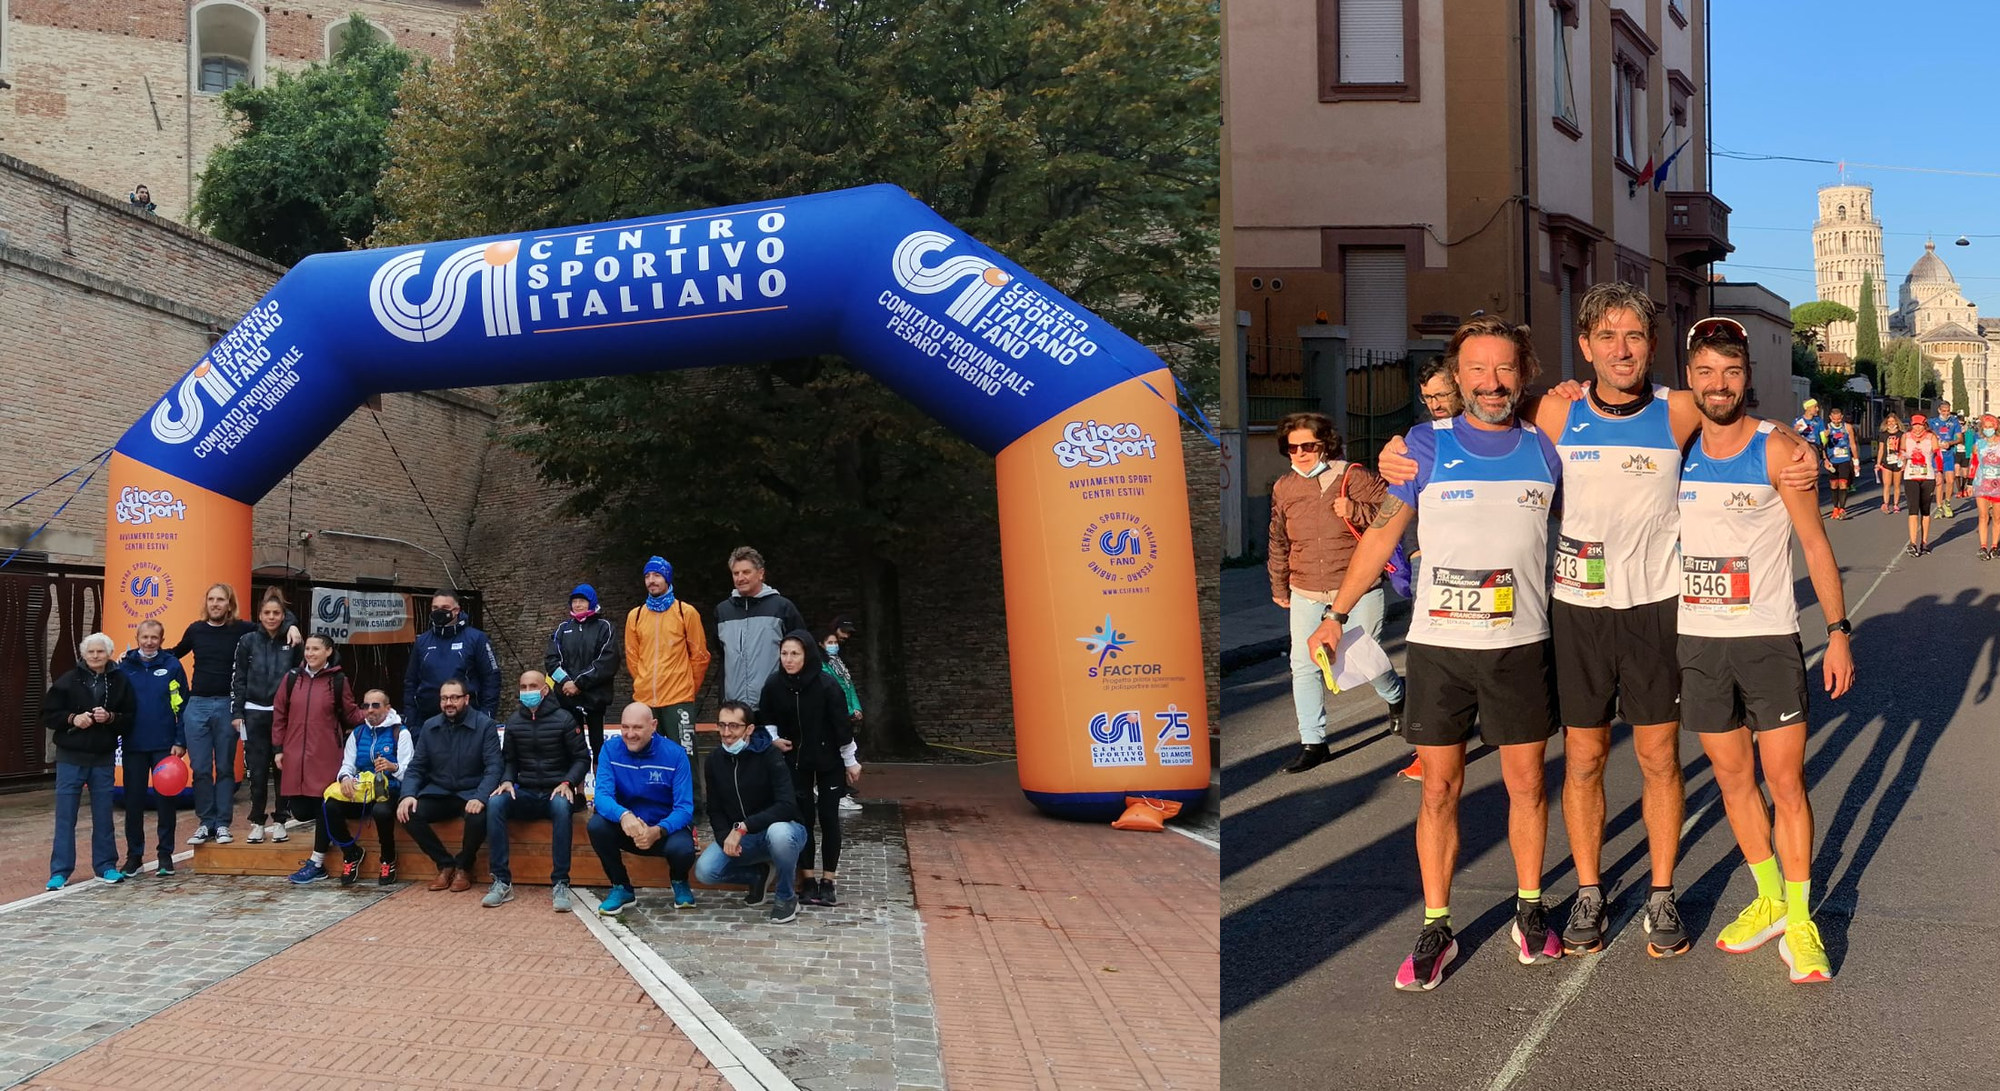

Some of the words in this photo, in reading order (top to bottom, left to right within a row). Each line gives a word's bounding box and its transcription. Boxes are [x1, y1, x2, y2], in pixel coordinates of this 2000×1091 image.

[529, 212, 786, 260] CENTRO
[528, 236, 785, 289] SPORTIVO
[529, 269, 786, 321] ITALIANO
[212, 307, 261, 358] CENTRO
[215, 300, 279, 366] SPORTIVO
[986, 302, 1078, 366] ITALIANO
[1000, 291, 1098, 356] SPORTIVO
[222, 312, 283, 376] ITALIANO
[878, 289, 945, 341] COMITATO
[943, 329, 1034, 397] PROVINCIALE
[972, 317, 1030, 360] FANO
[231, 346, 271, 388] FANO
[886, 316, 941, 358] PESARO
[947, 354, 1002, 397] URBINO
[193, 407, 244, 458] COMITATO
[238, 345, 304, 414] PROVINCIALE
[217, 414, 259, 455] PESARO
[260, 370, 301, 412] URBINO
[1063, 420, 1142, 447] Gioco
[1570, 450, 1600, 461] AVIS
[121, 486, 173, 507] Gioco
[1069, 475, 1126, 489] AVVIAMENTO
[1128, 475, 1152, 484] SPORT
[1082, 489, 1114, 499] CENTRI
[1117, 487, 1145, 496] ESTIVI
[1441, 489, 1474, 500] AVIS
[1099, 512, 1140, 524] SPORTIVO
[1081, 523, 1098, 552] CENTRO
[1141, 524, 1157, 559] ITALIANO
[1088, 561, 1117, 582] URBINO
[1110, 557, 1136, 566] FANO
[1127, 562, 1154, 582] PESARO
[1556, 553, 1577, 578] 213
[1694, 560, 1717, 571] TEN
[132, 562, 162, 573] SPORTIVO
[162, 572, 174, 601] ITALIANO
[1685, 574, 1727, 596] 1546
[1439, 588, 1481, 611] 212
[316, 626, 349, 638] FANO
[1103, 664, 1162, 677] FACTOR
